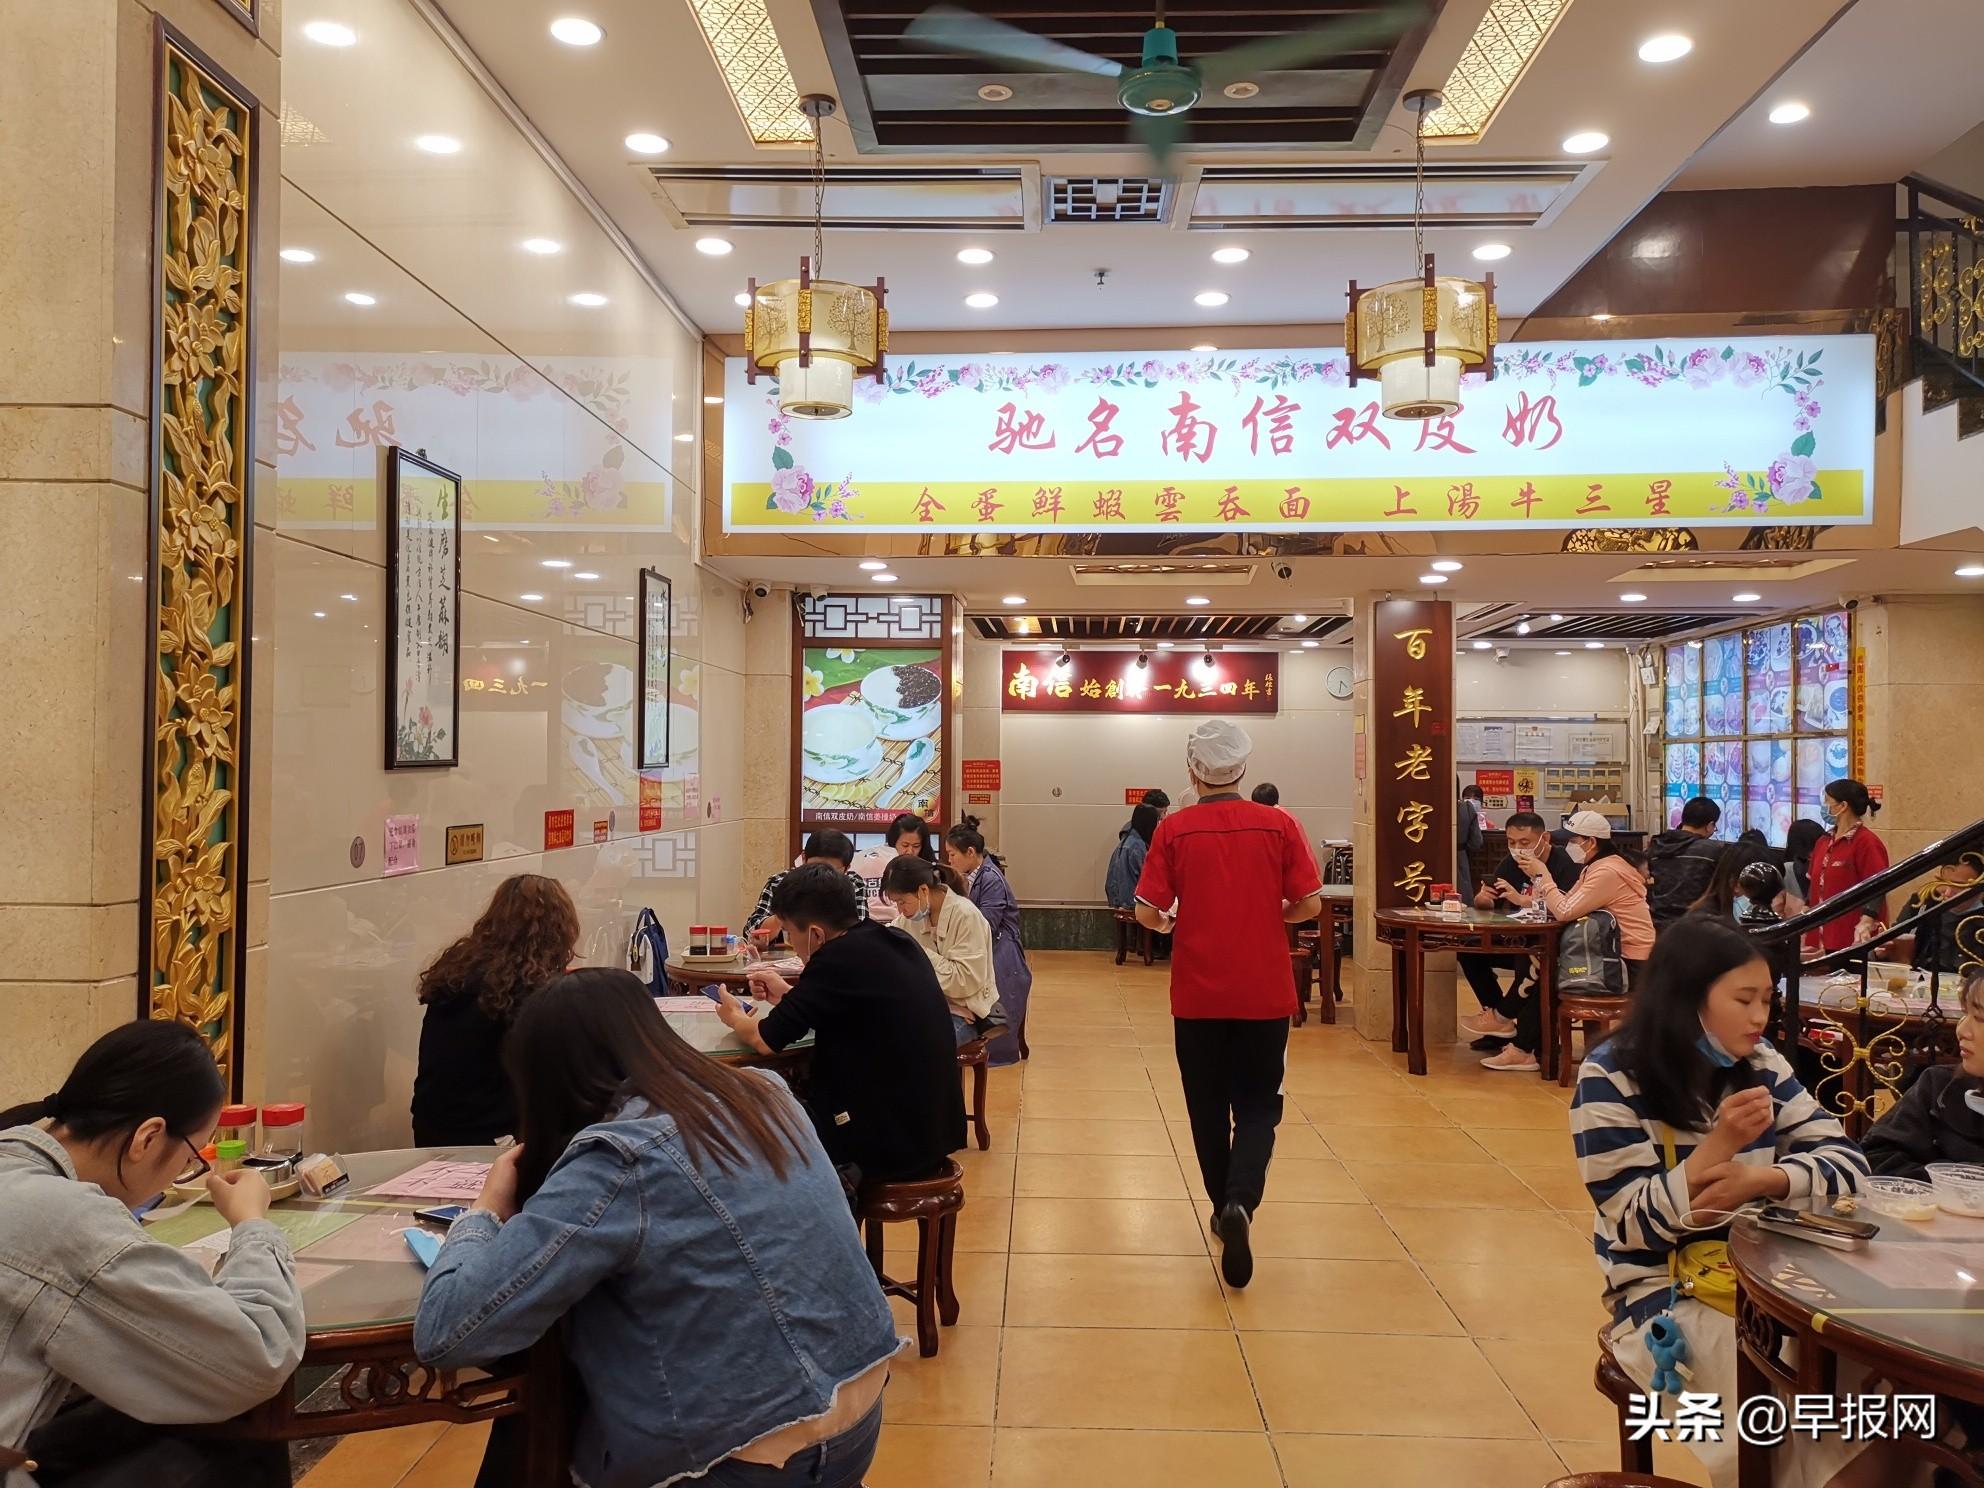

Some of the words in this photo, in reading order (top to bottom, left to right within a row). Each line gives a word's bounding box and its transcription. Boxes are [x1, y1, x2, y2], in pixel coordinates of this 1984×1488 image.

[988, 390, 1563, 464] 驰名南信双皮奶
[911, 486, 1311, 523] 全蛋鮮蝦雲吞面
[1384, 480, 1674, 519] 上湯牛三星
[1008, 662, 1260, 701] 南信始創一九三四年
[1393, 628, 1434, 902] 百年老字号
